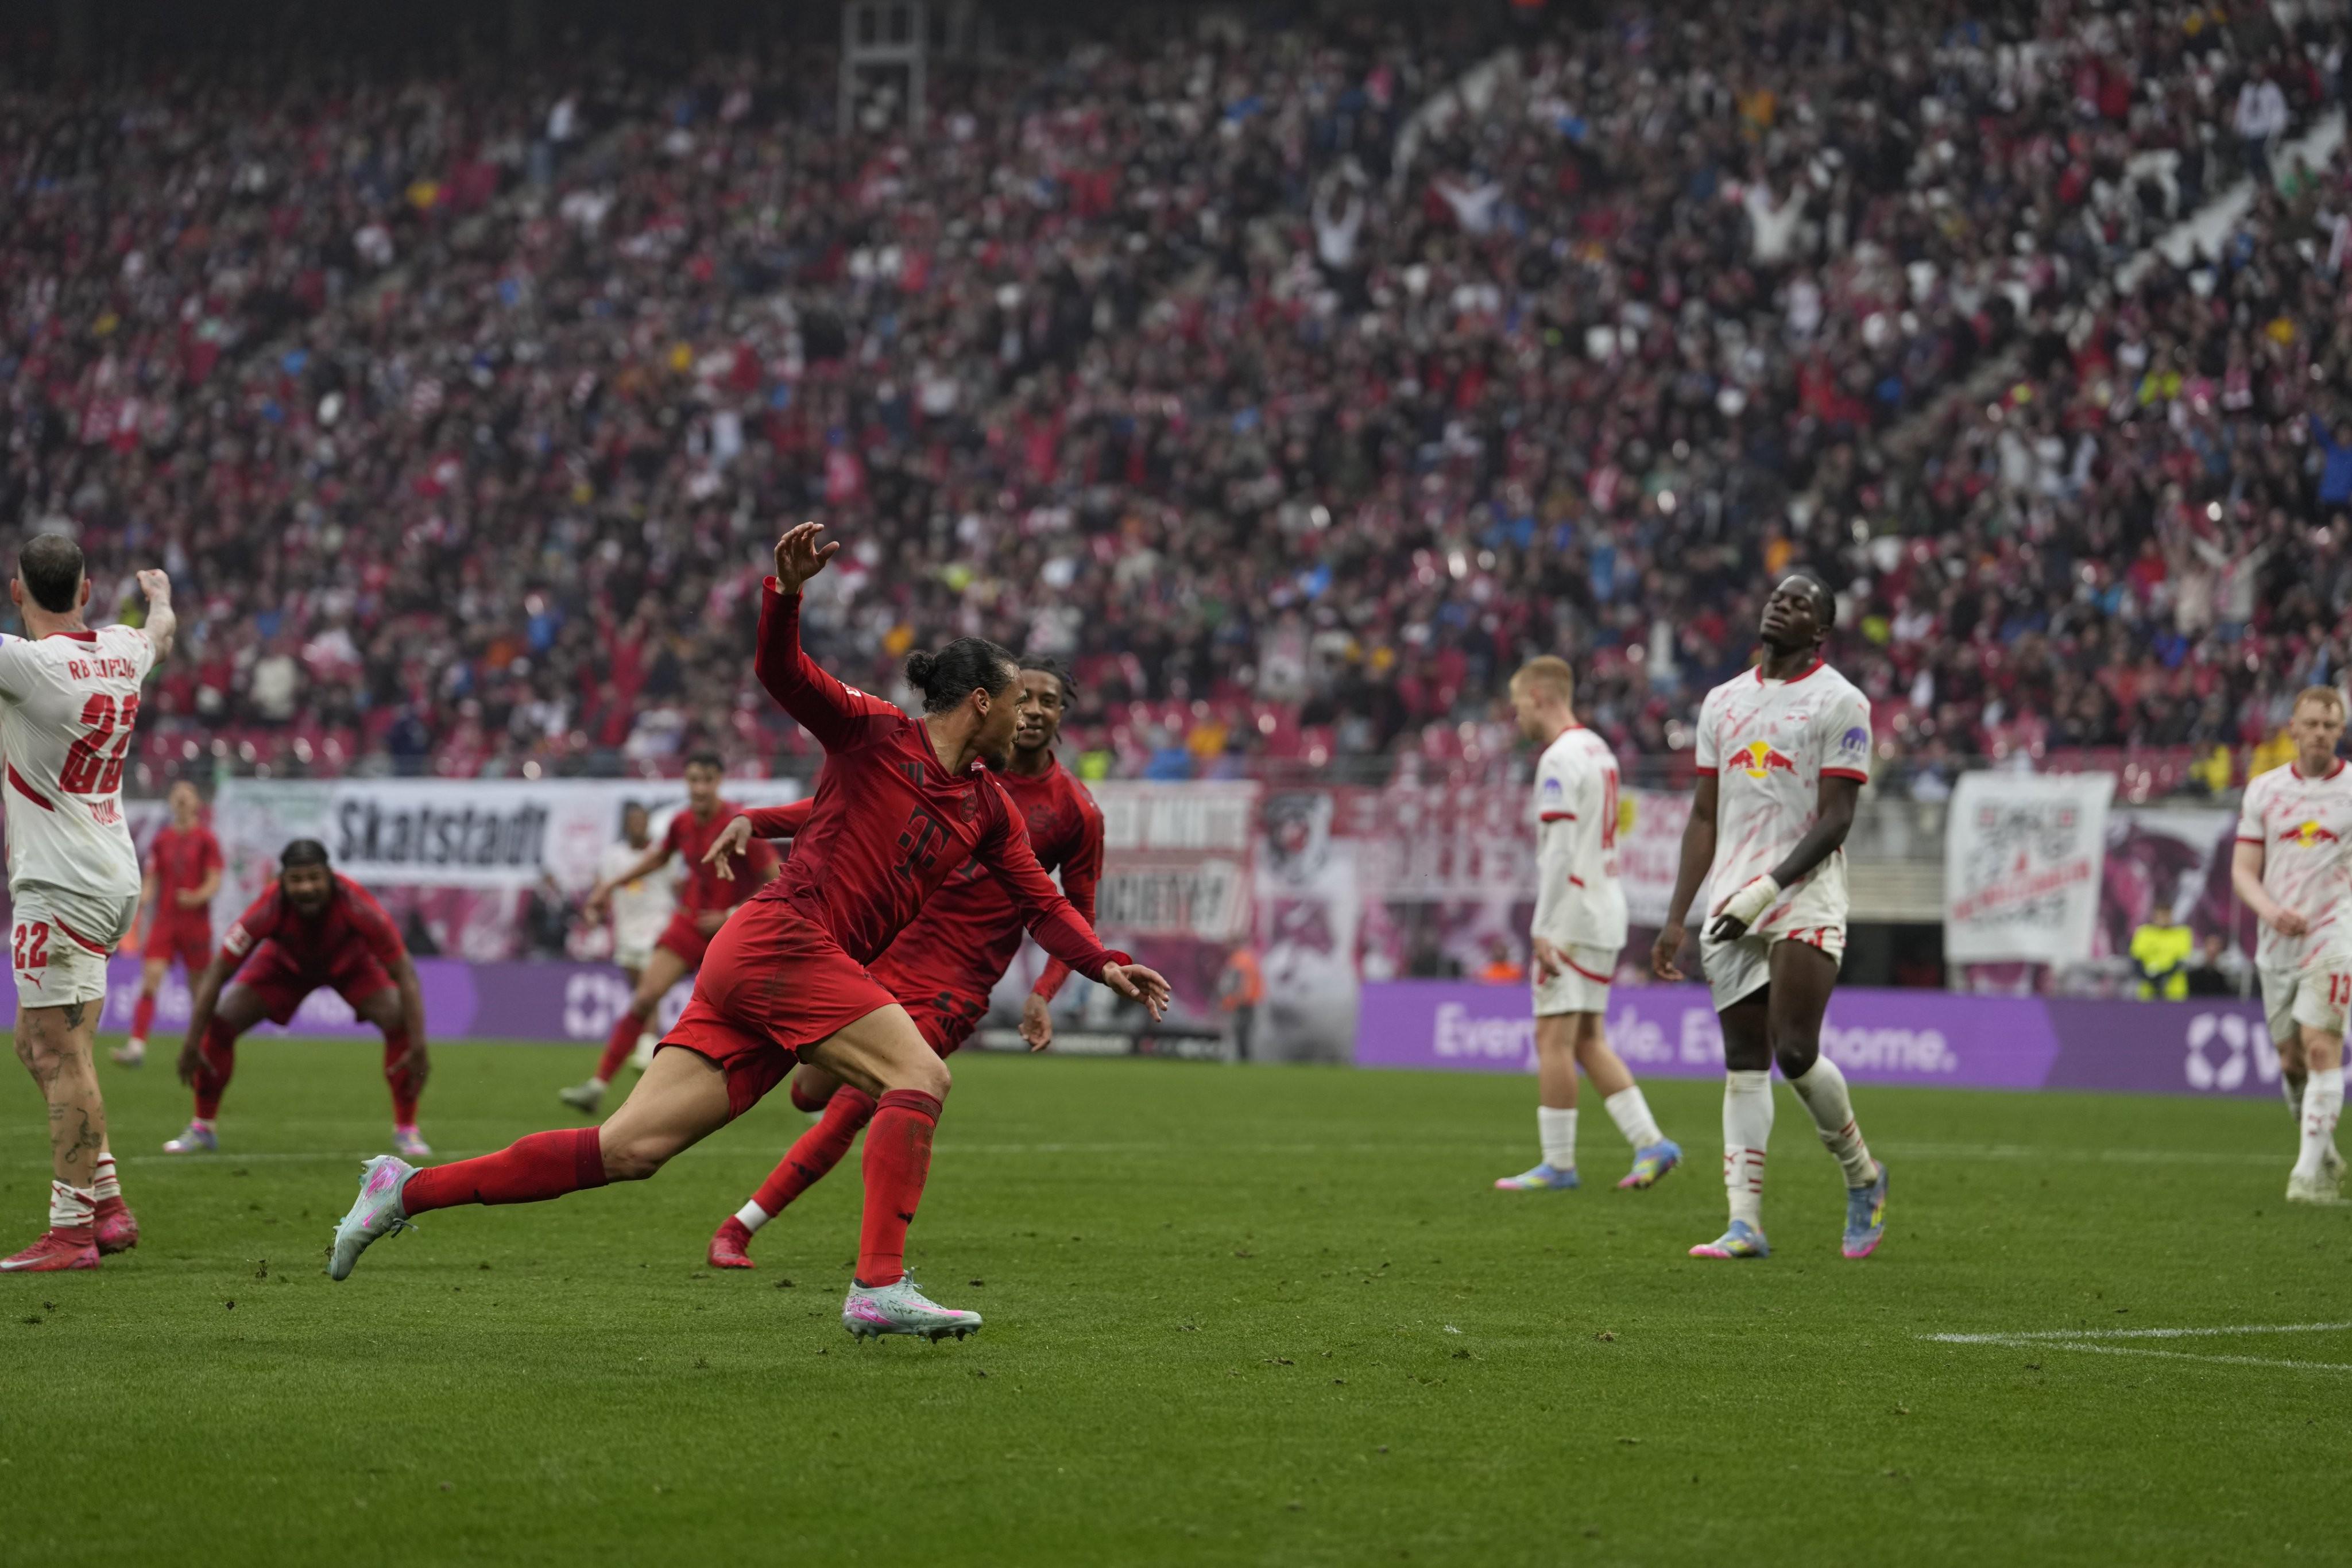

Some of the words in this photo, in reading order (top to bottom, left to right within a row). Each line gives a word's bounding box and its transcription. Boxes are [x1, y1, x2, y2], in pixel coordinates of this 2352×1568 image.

[68, 659, 90, 680] RB
[59, 693, 140, 793] 22
[339, 799, 548, 864] Skatstadt
[15, 922, 49, 969] 22
[2329, 974, 2351, 1005] 13
